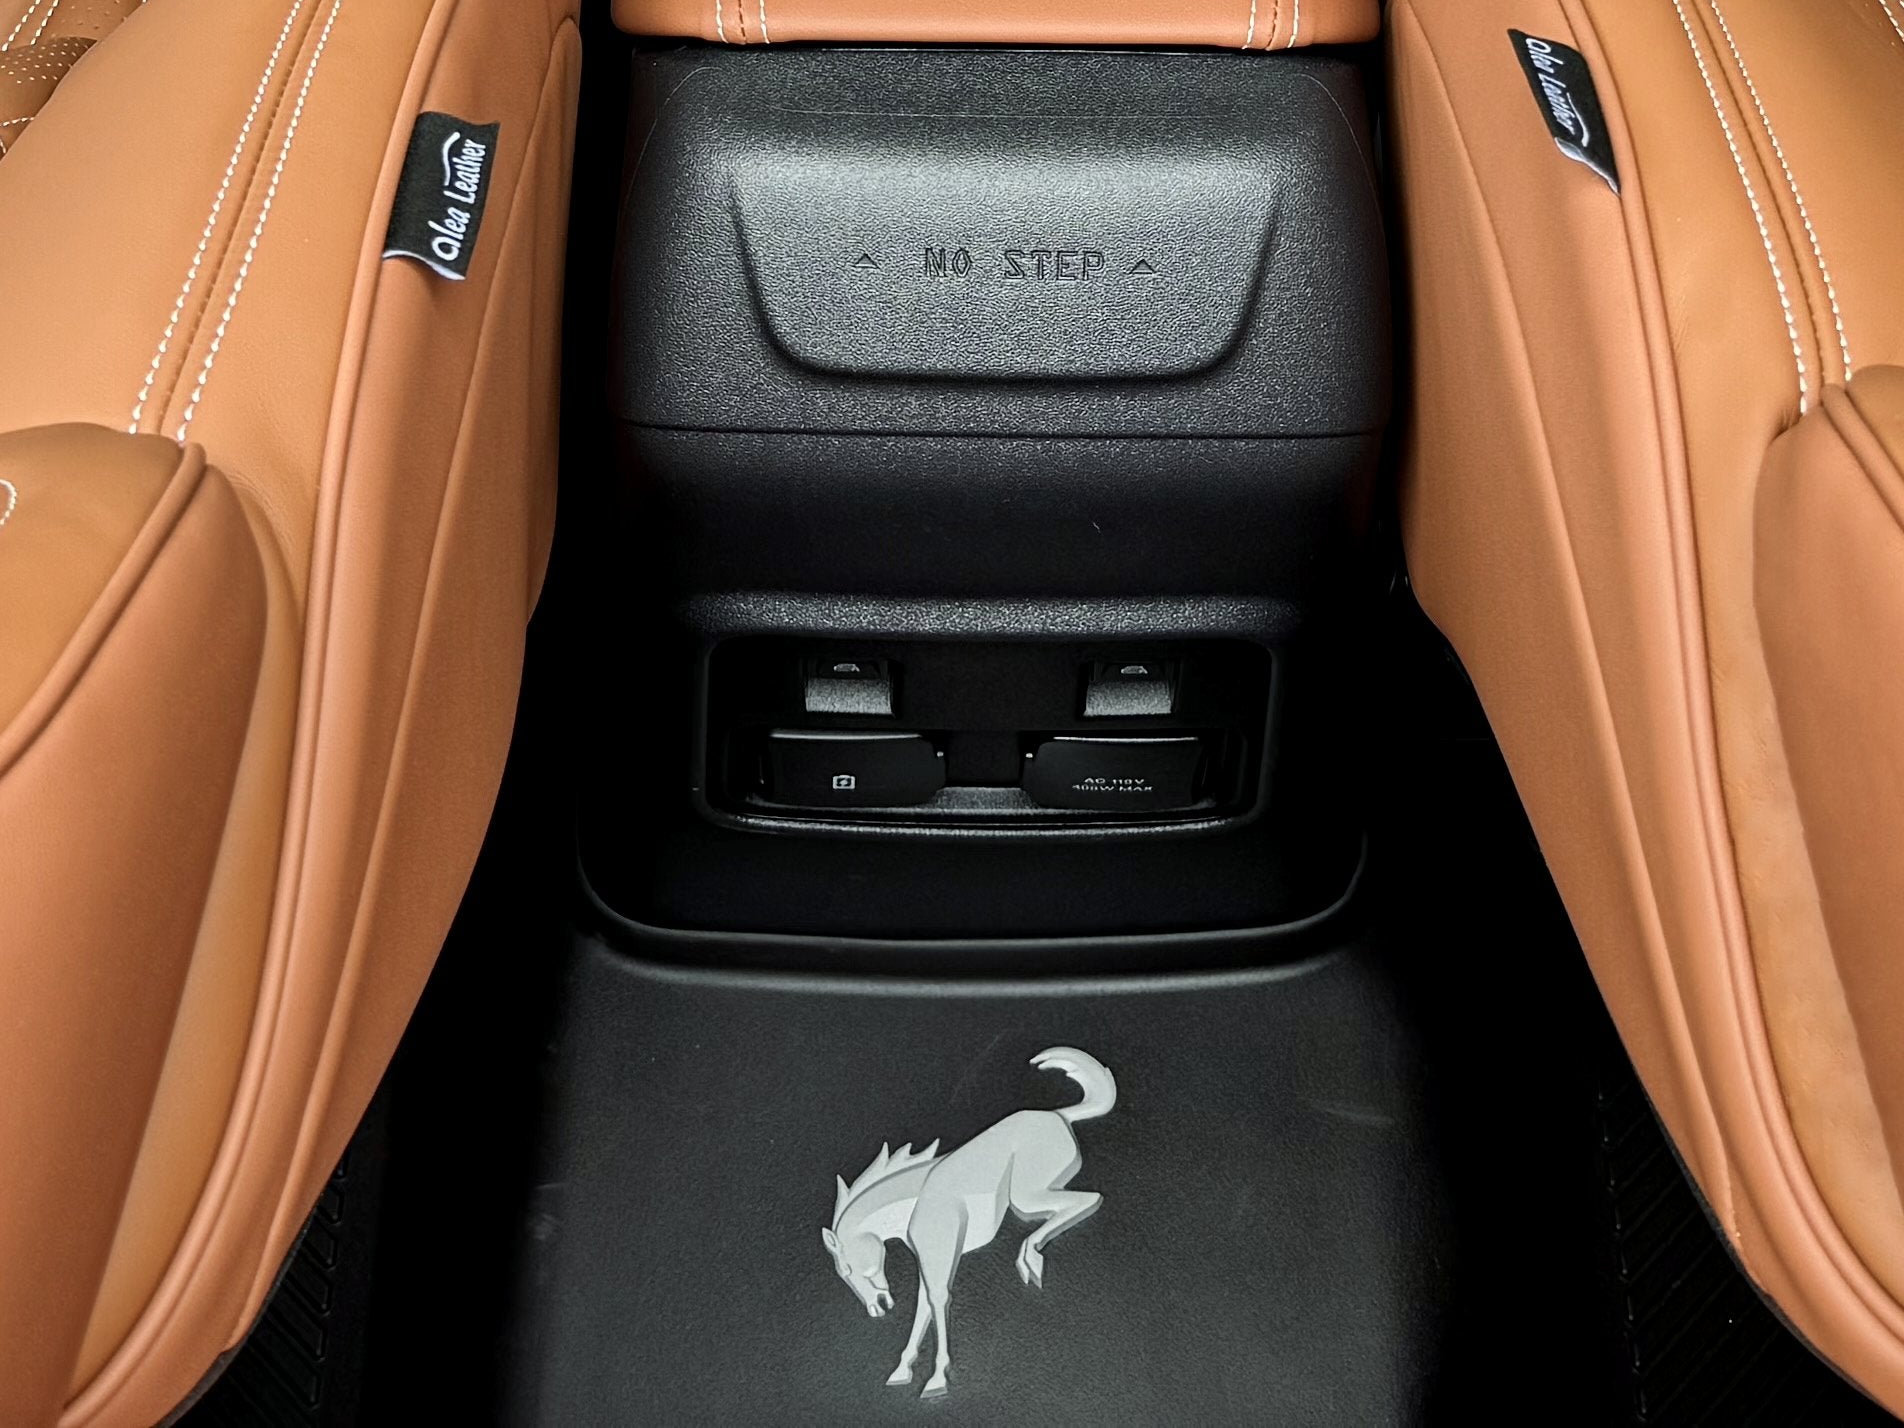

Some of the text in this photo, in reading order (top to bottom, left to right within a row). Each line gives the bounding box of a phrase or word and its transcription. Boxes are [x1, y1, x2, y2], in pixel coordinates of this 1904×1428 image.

[443, 138, 486, 204] Leather
[924, 247, 1107, 282] NO STEP
